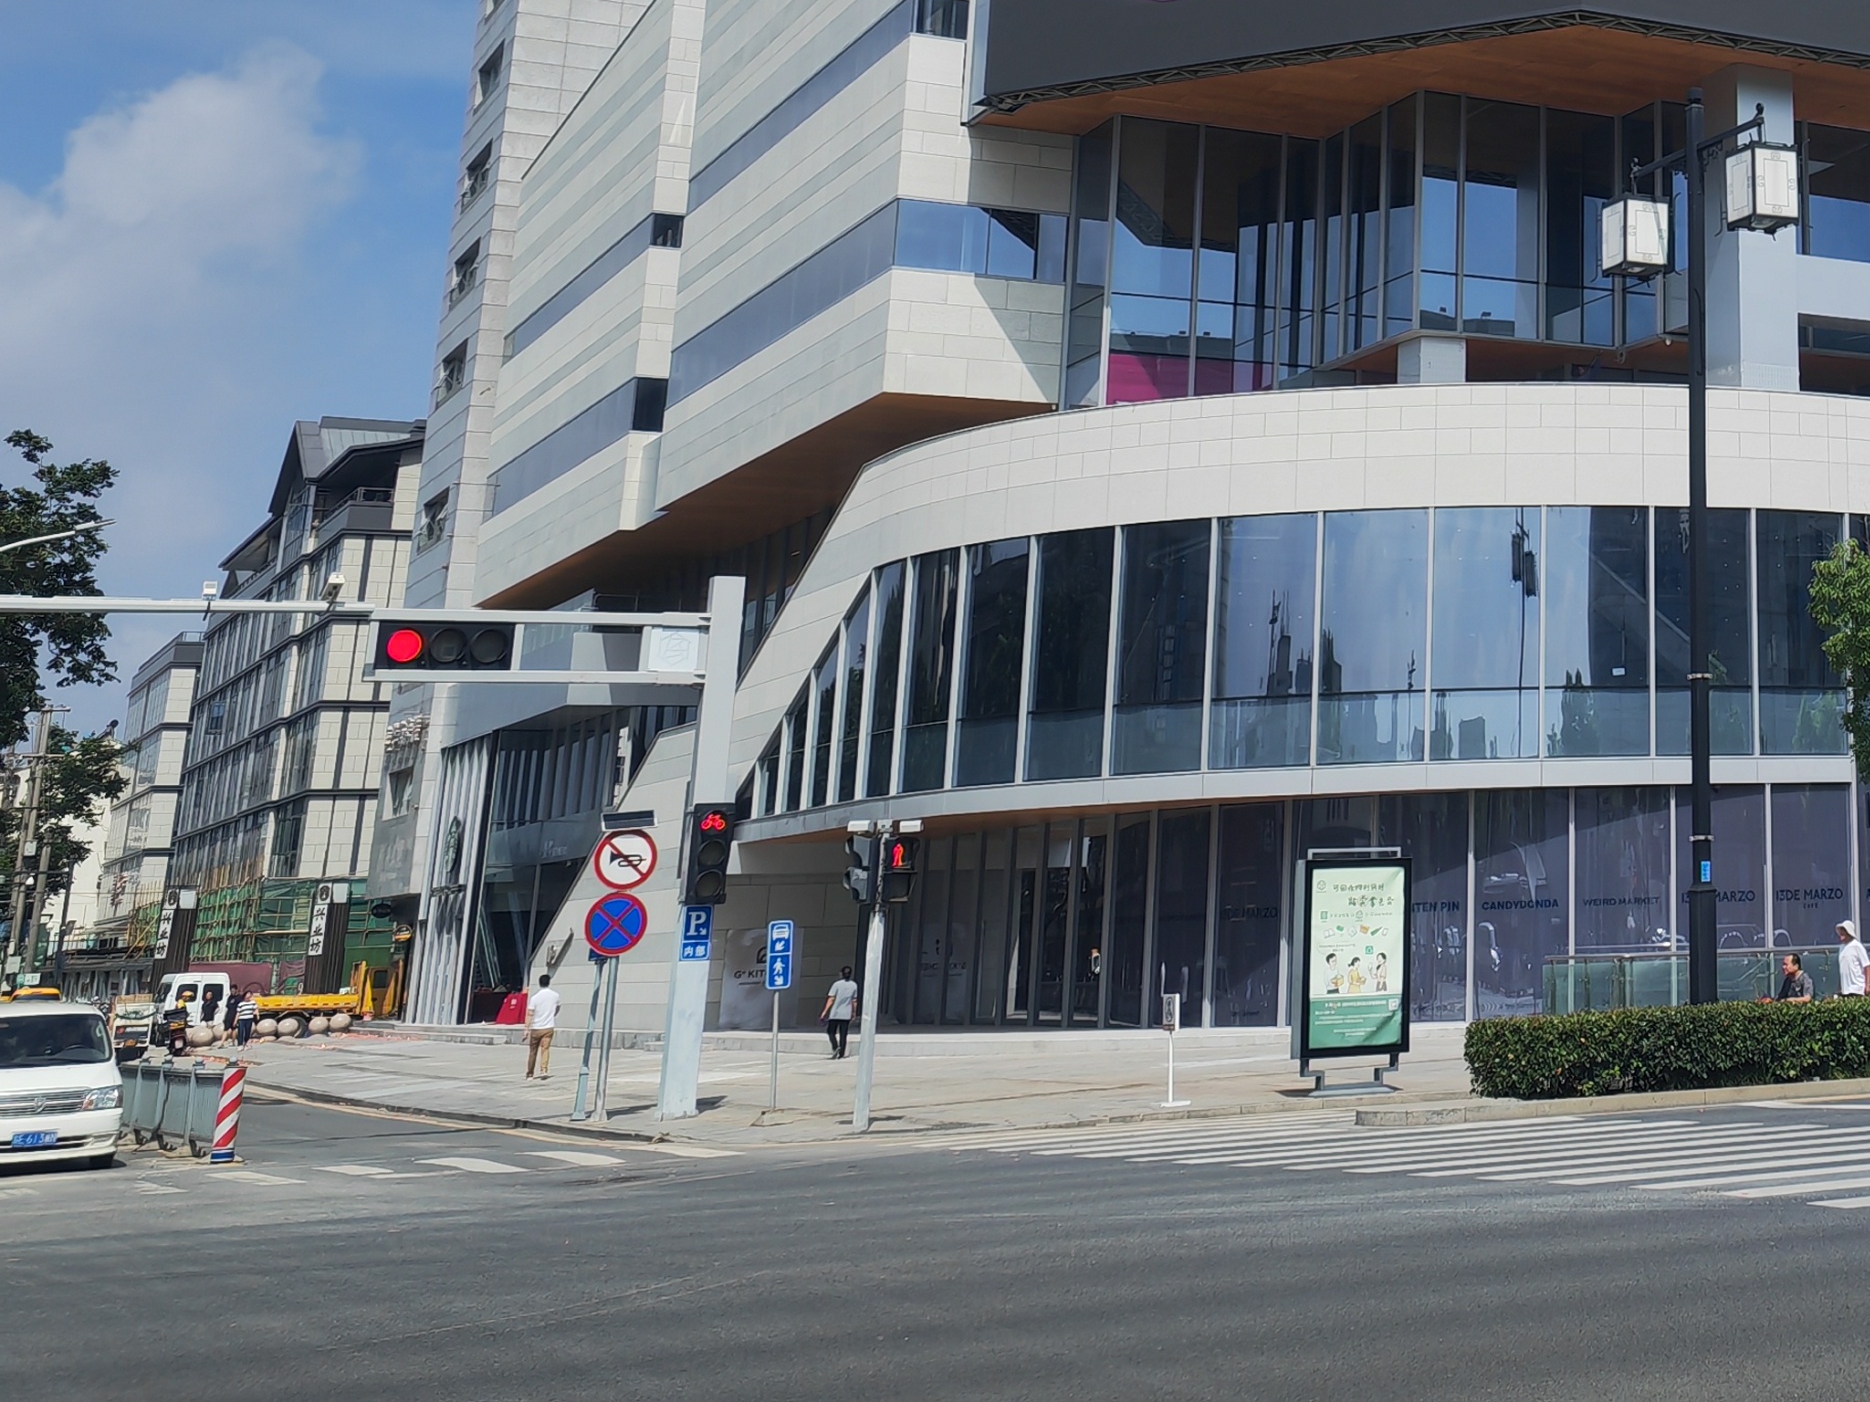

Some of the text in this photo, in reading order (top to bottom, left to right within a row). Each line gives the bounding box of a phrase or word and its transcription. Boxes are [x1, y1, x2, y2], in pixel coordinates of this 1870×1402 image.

[1803, 888, 1844, 901] MARZO
[1440, 901, 1460, 912] PIN
[1481, 899, 1560, 910] CANDYDONDA
[686, 911, 707, 936] P
[683, 944, 706, 958] 内部
